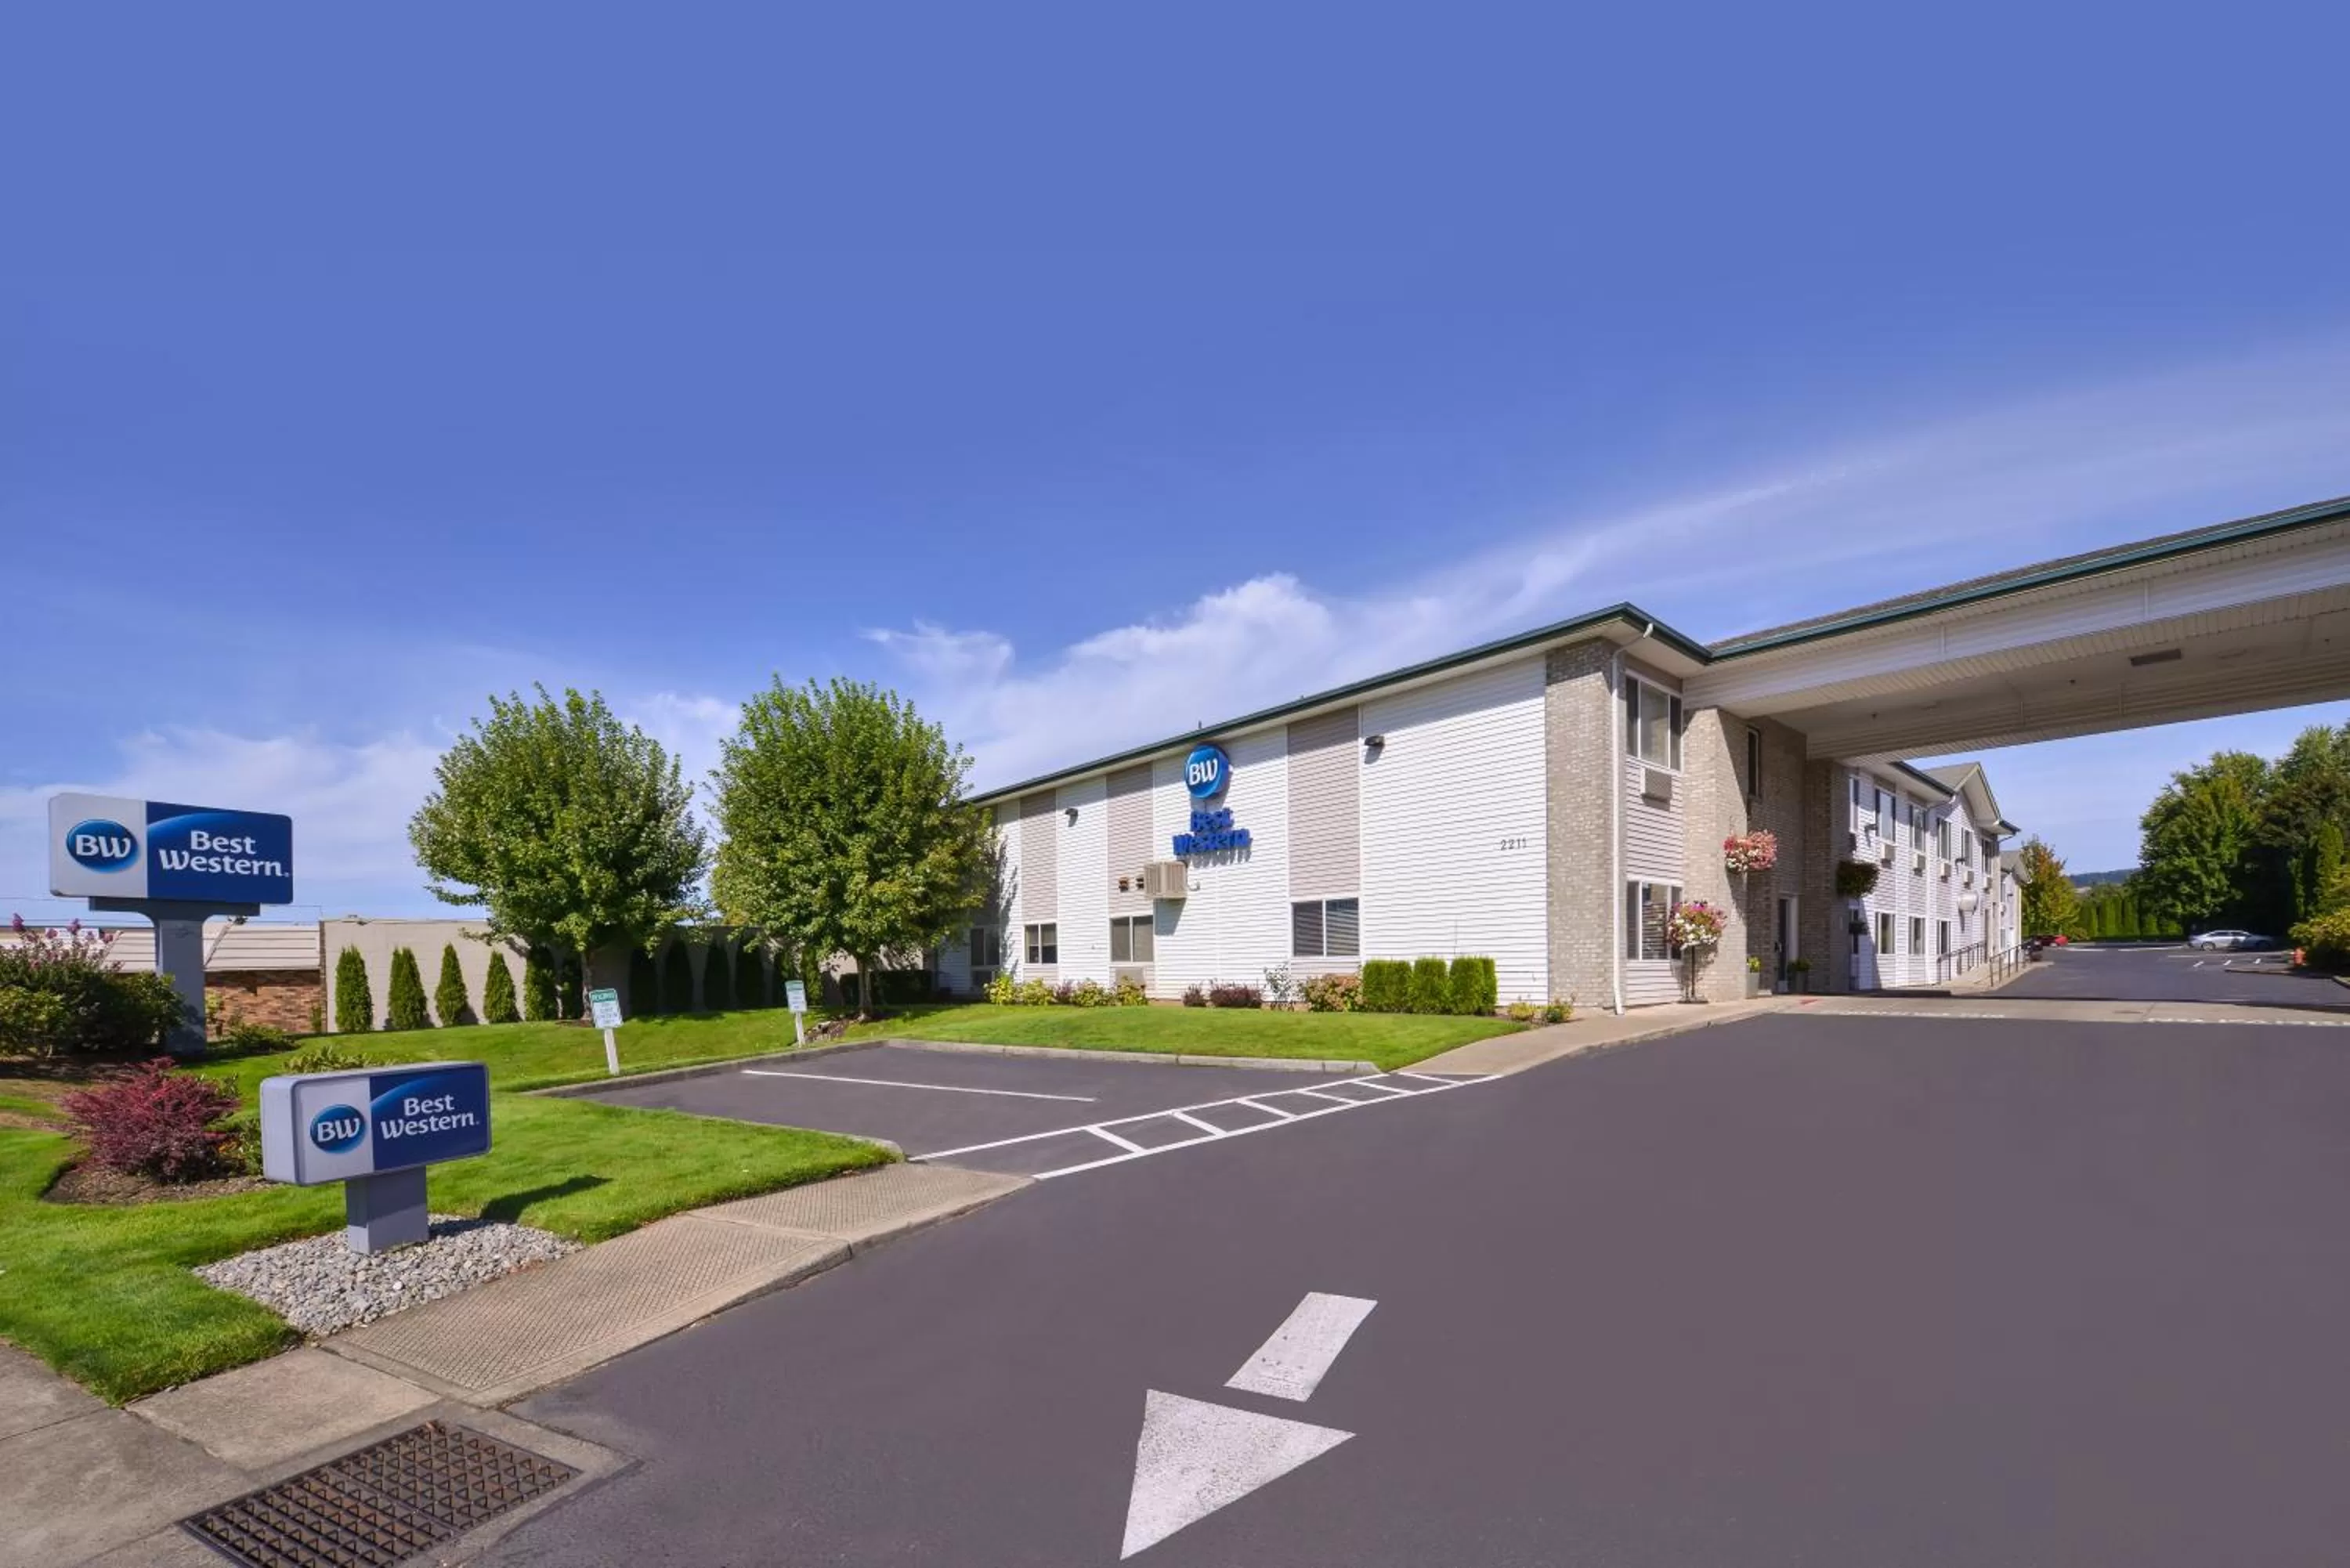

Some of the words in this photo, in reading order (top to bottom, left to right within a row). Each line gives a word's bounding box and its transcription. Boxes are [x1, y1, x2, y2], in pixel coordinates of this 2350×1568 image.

[1188, 757, 1219, 786] BW
[75, 834, 132, 858] BW
[190, 830, 257, 855] Best
[1500, 837, 1527, 851] 2211
[403, 1094, 455, 1117] Best
[316, 1118, 360, 1143] BW
